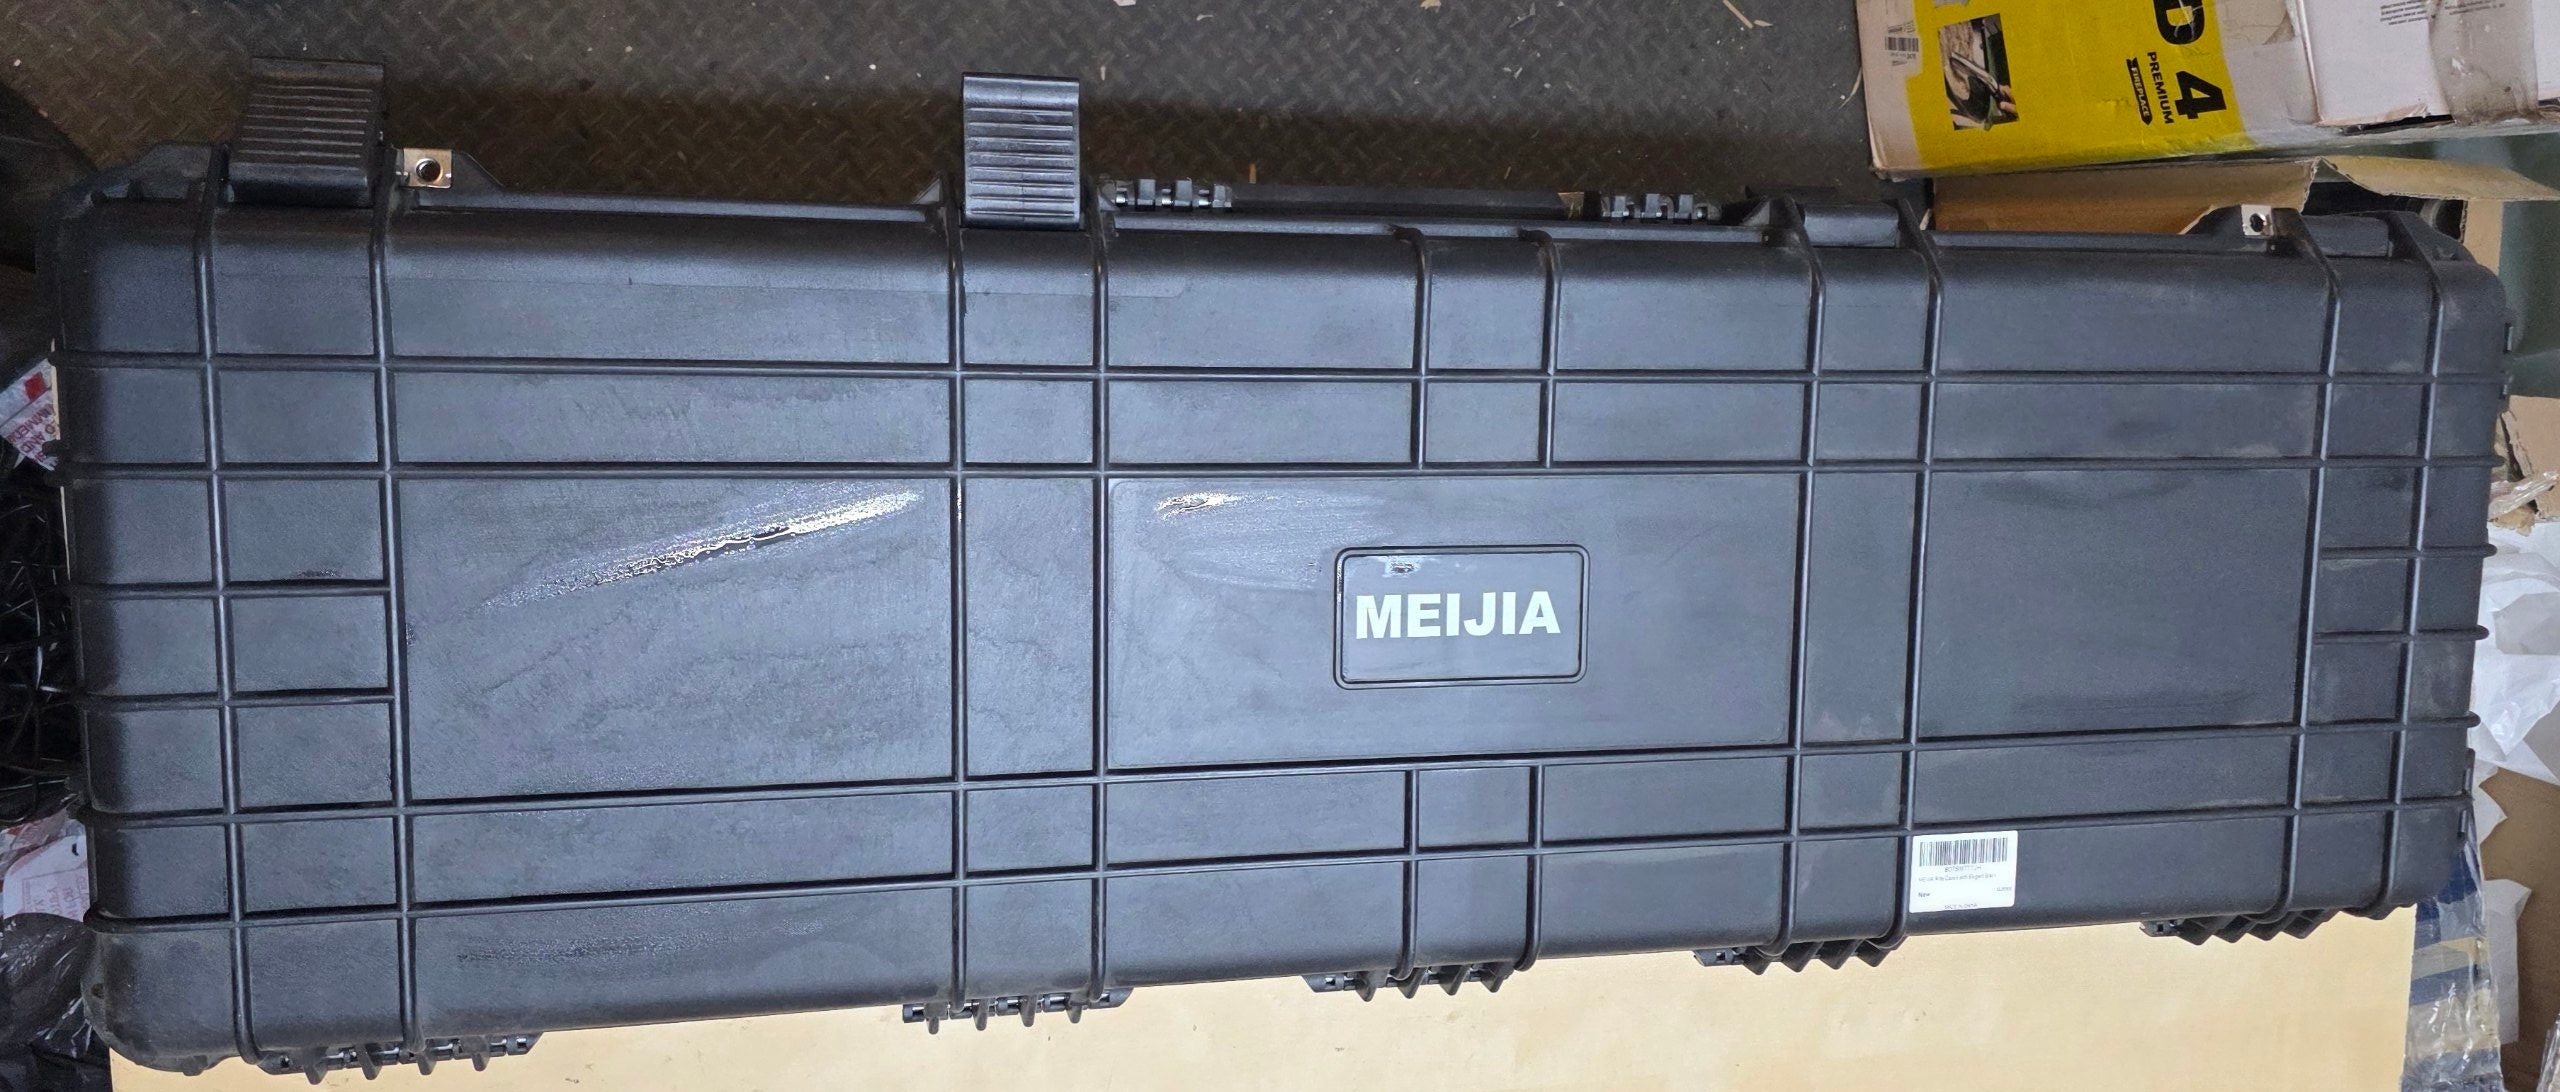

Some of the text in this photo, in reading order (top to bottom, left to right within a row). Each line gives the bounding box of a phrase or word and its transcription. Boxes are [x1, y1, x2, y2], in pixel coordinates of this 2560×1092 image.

[2131, 67, 2150, 117] FIREPLACE
[2147, 51, 2174, 124] PREMIUM
[2174, 70, 2227, 120] 4
[1356, 591, 1561, 639] MEIJIA
